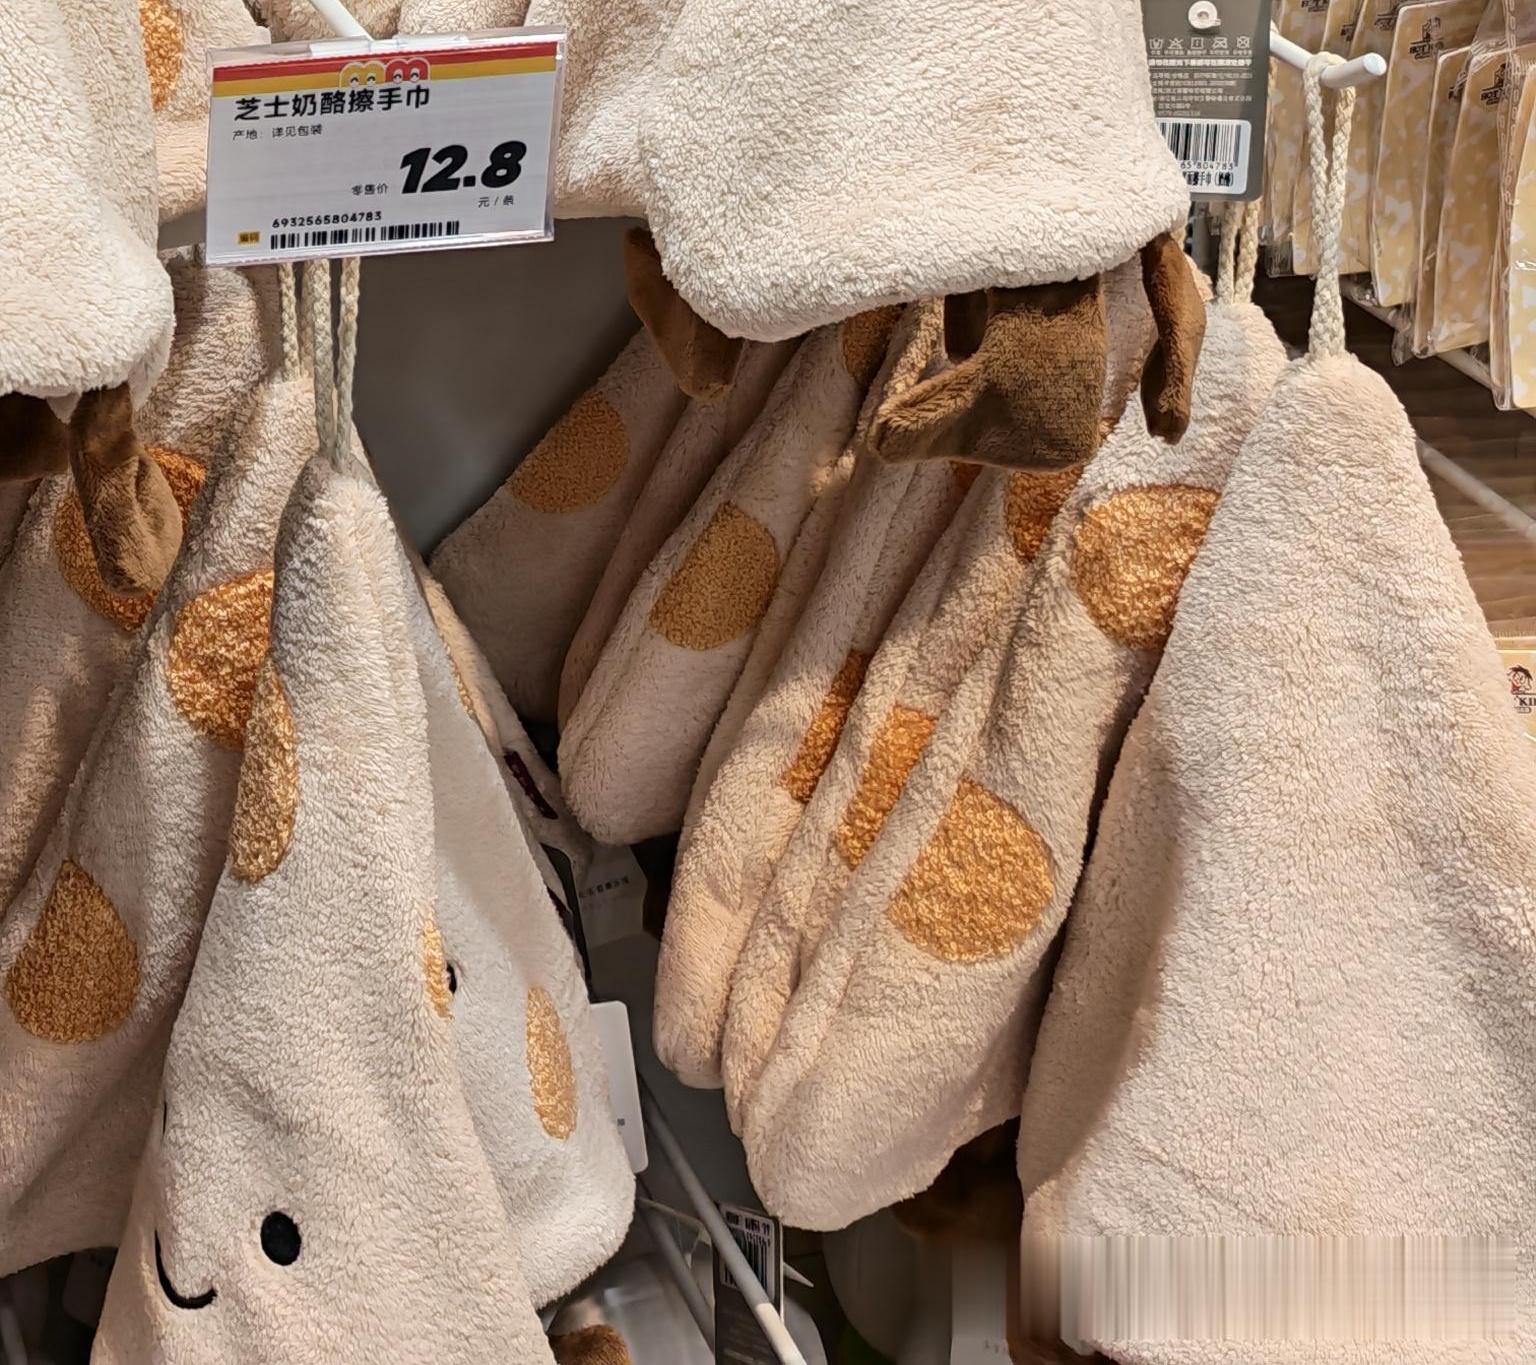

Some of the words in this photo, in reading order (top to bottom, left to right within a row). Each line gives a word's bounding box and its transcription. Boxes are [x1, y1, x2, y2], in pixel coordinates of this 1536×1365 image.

[234, 85, 430, 121] 芝士奶酪擦手巾
[400, 140, 527, 194] 12.8
[271, 211, 382, 229] 6932565804783
